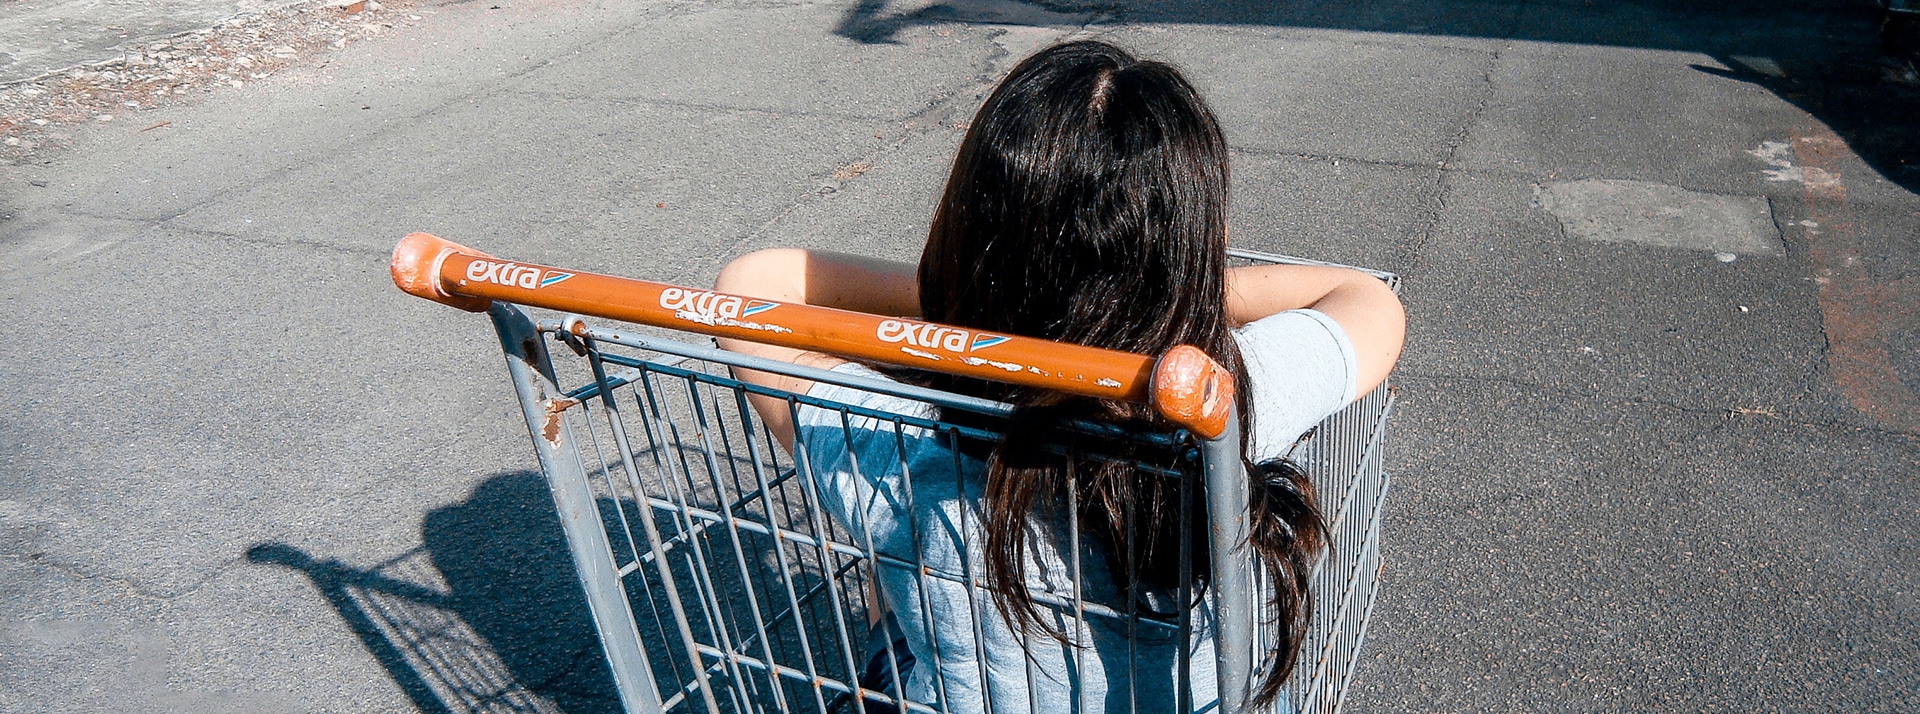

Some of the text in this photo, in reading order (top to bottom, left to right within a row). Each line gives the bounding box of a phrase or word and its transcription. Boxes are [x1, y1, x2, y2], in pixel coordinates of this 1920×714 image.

[466, 260, 541, 290] extra
[660, 287, 743, 319] extra
[877, 320, 970, 353] extra
